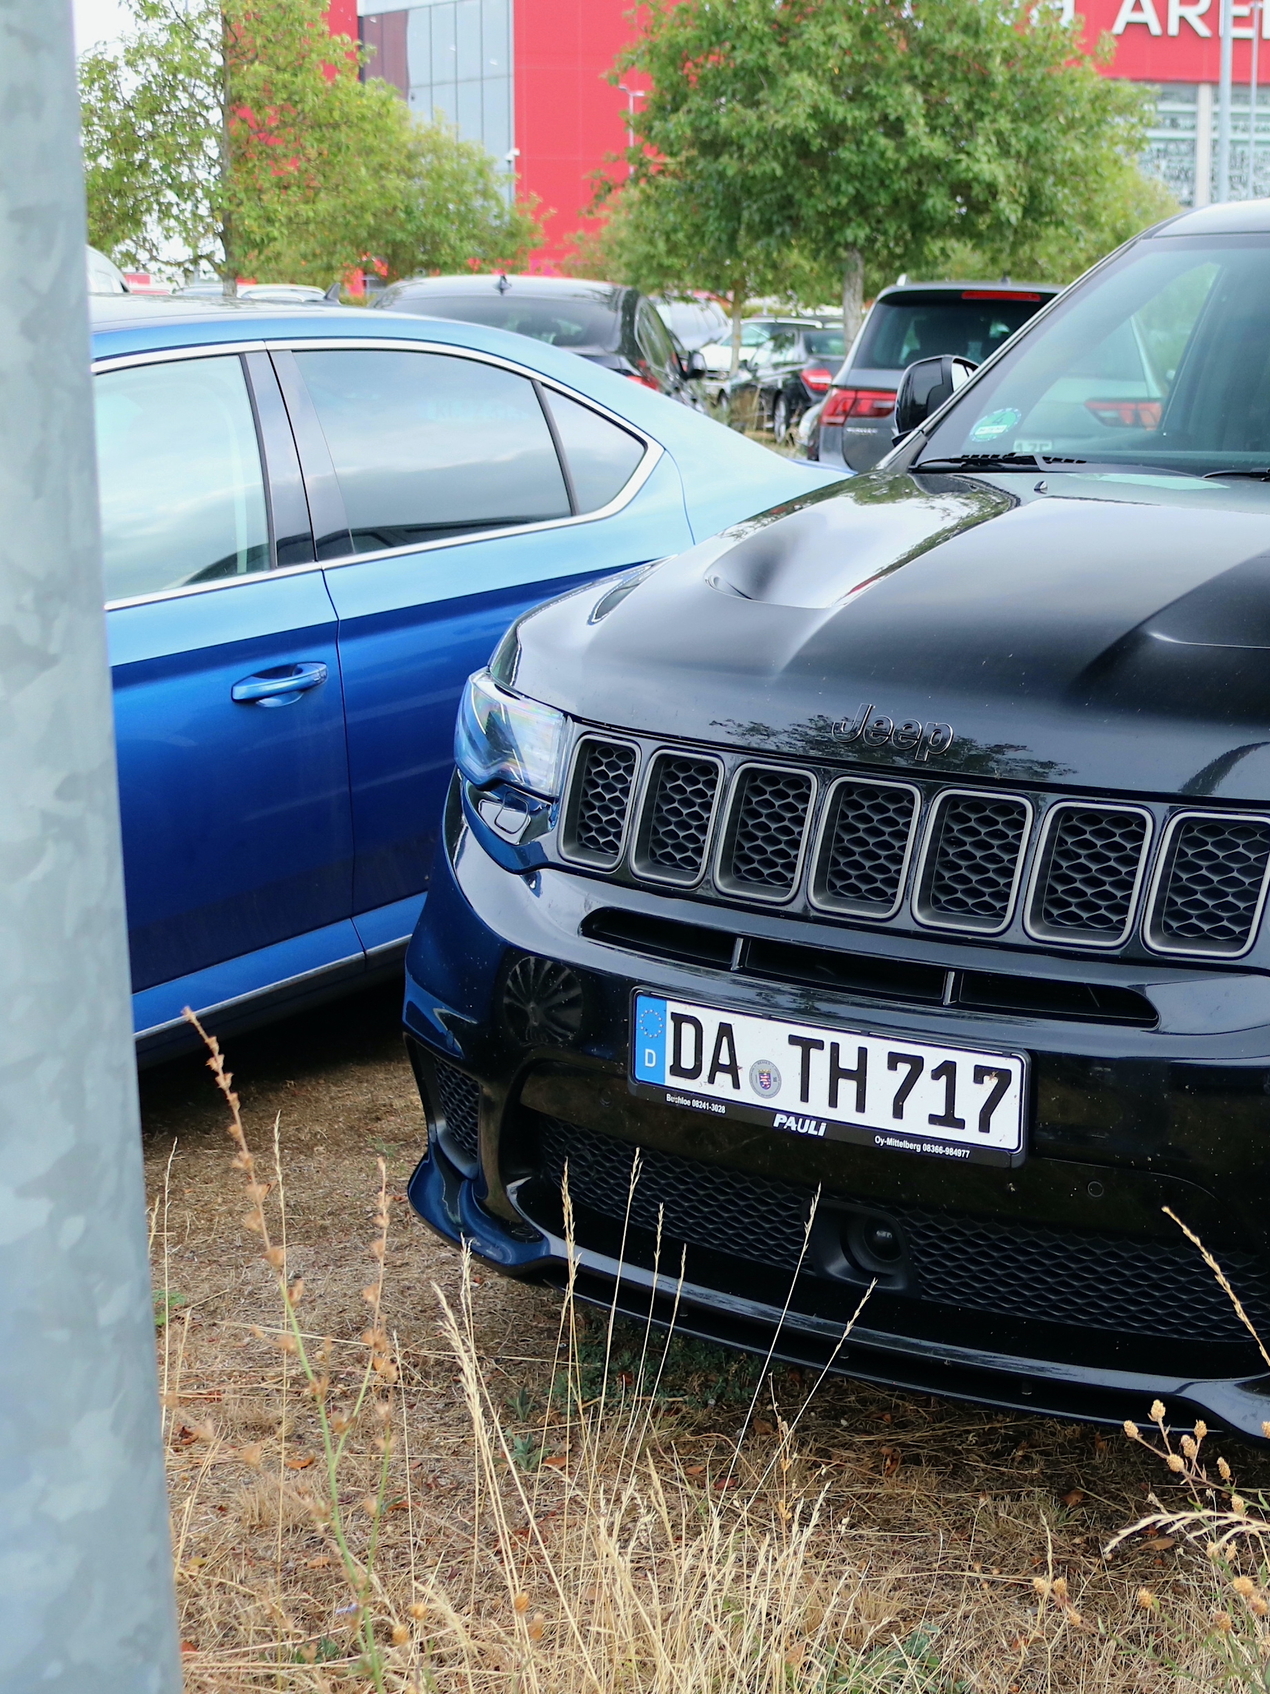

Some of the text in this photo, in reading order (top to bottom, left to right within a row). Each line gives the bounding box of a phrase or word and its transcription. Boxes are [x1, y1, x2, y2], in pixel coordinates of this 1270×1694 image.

[831, 703, 954, 761] Jeep
[644, 1049, 657, 1068] D
[669, 1011, 741, 1090] DA
[788, 1034, 868, 1113] TH
[887, 1051, 1012, 1133] 717
[692, 1099, 726, 1114] 08241-3028
[874, 1135, 921, 1153] Oy-Mittelberg
